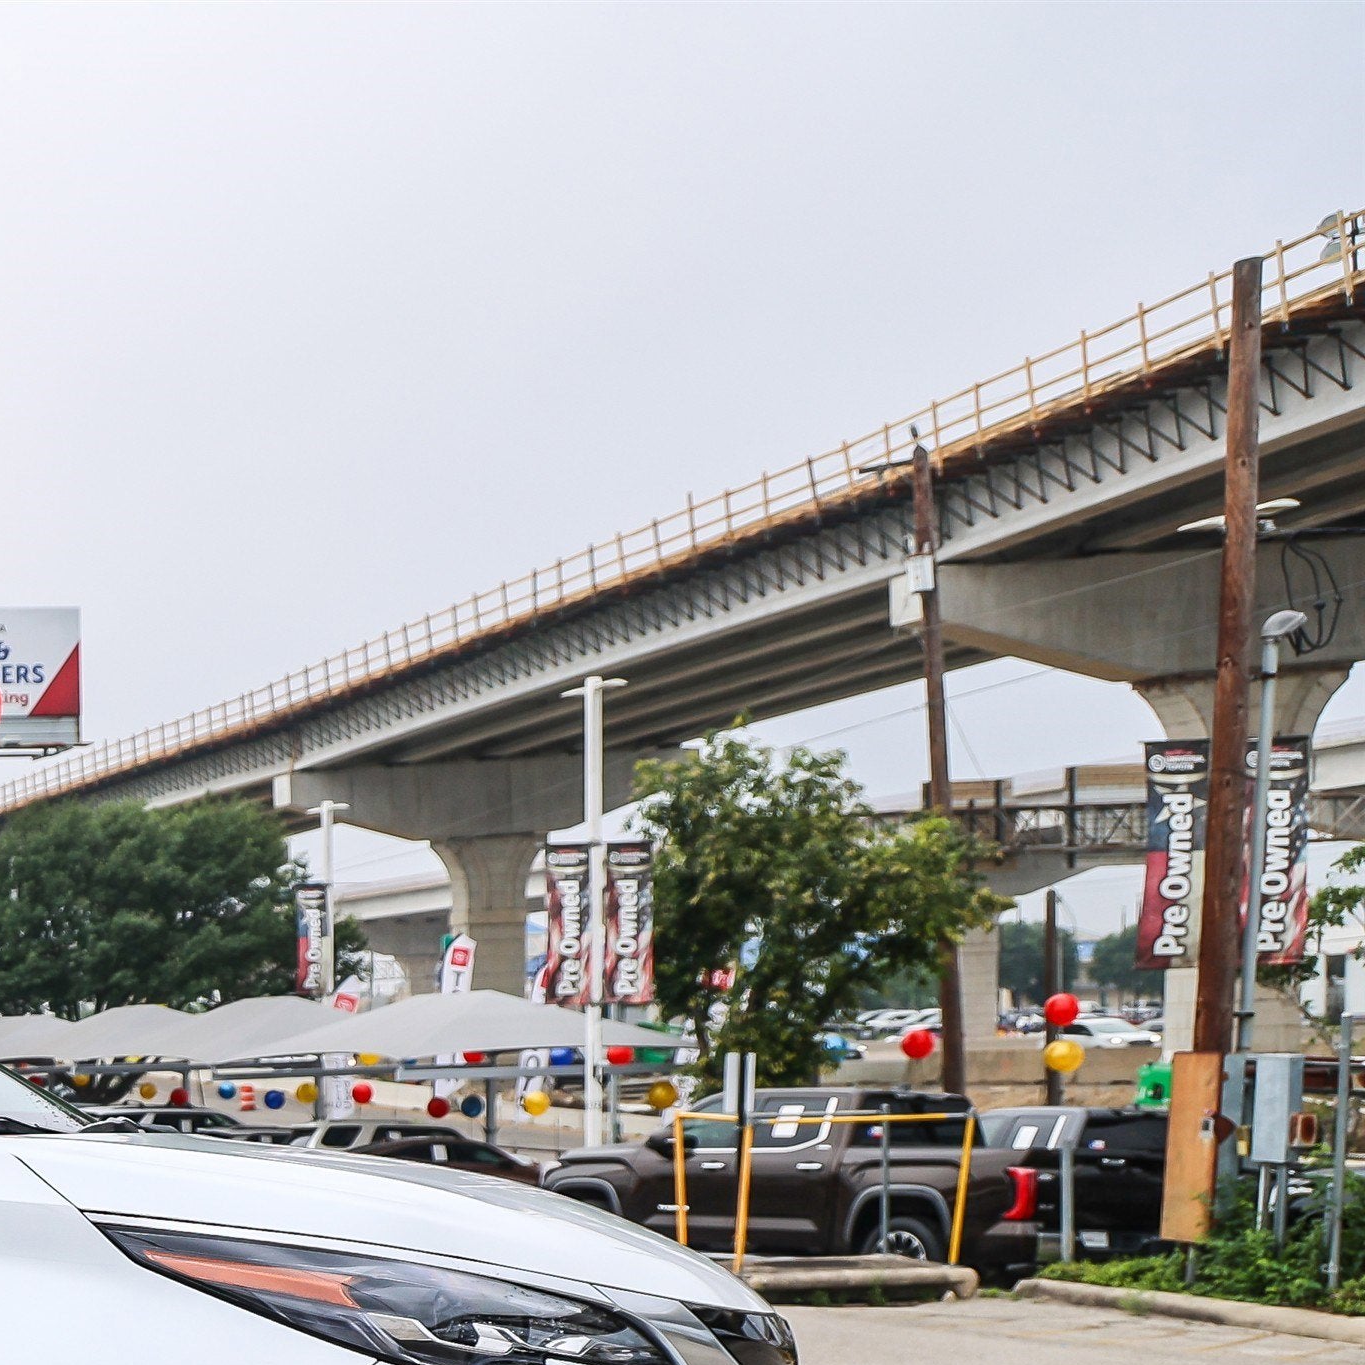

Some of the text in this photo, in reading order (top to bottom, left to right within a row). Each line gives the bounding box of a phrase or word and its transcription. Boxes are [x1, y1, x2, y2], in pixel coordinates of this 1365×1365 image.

[1159, 793, 1193, 899] Owned
[555, 880, 581, 956] Owned
[614, 879, 639, 955] Owned
[1153, 904, 1189, 957] Pre
[1256, 900, 1287, 952] Pre
[555, 958, 580, 996] Pre
[613, 958, 638, 996] Pre
